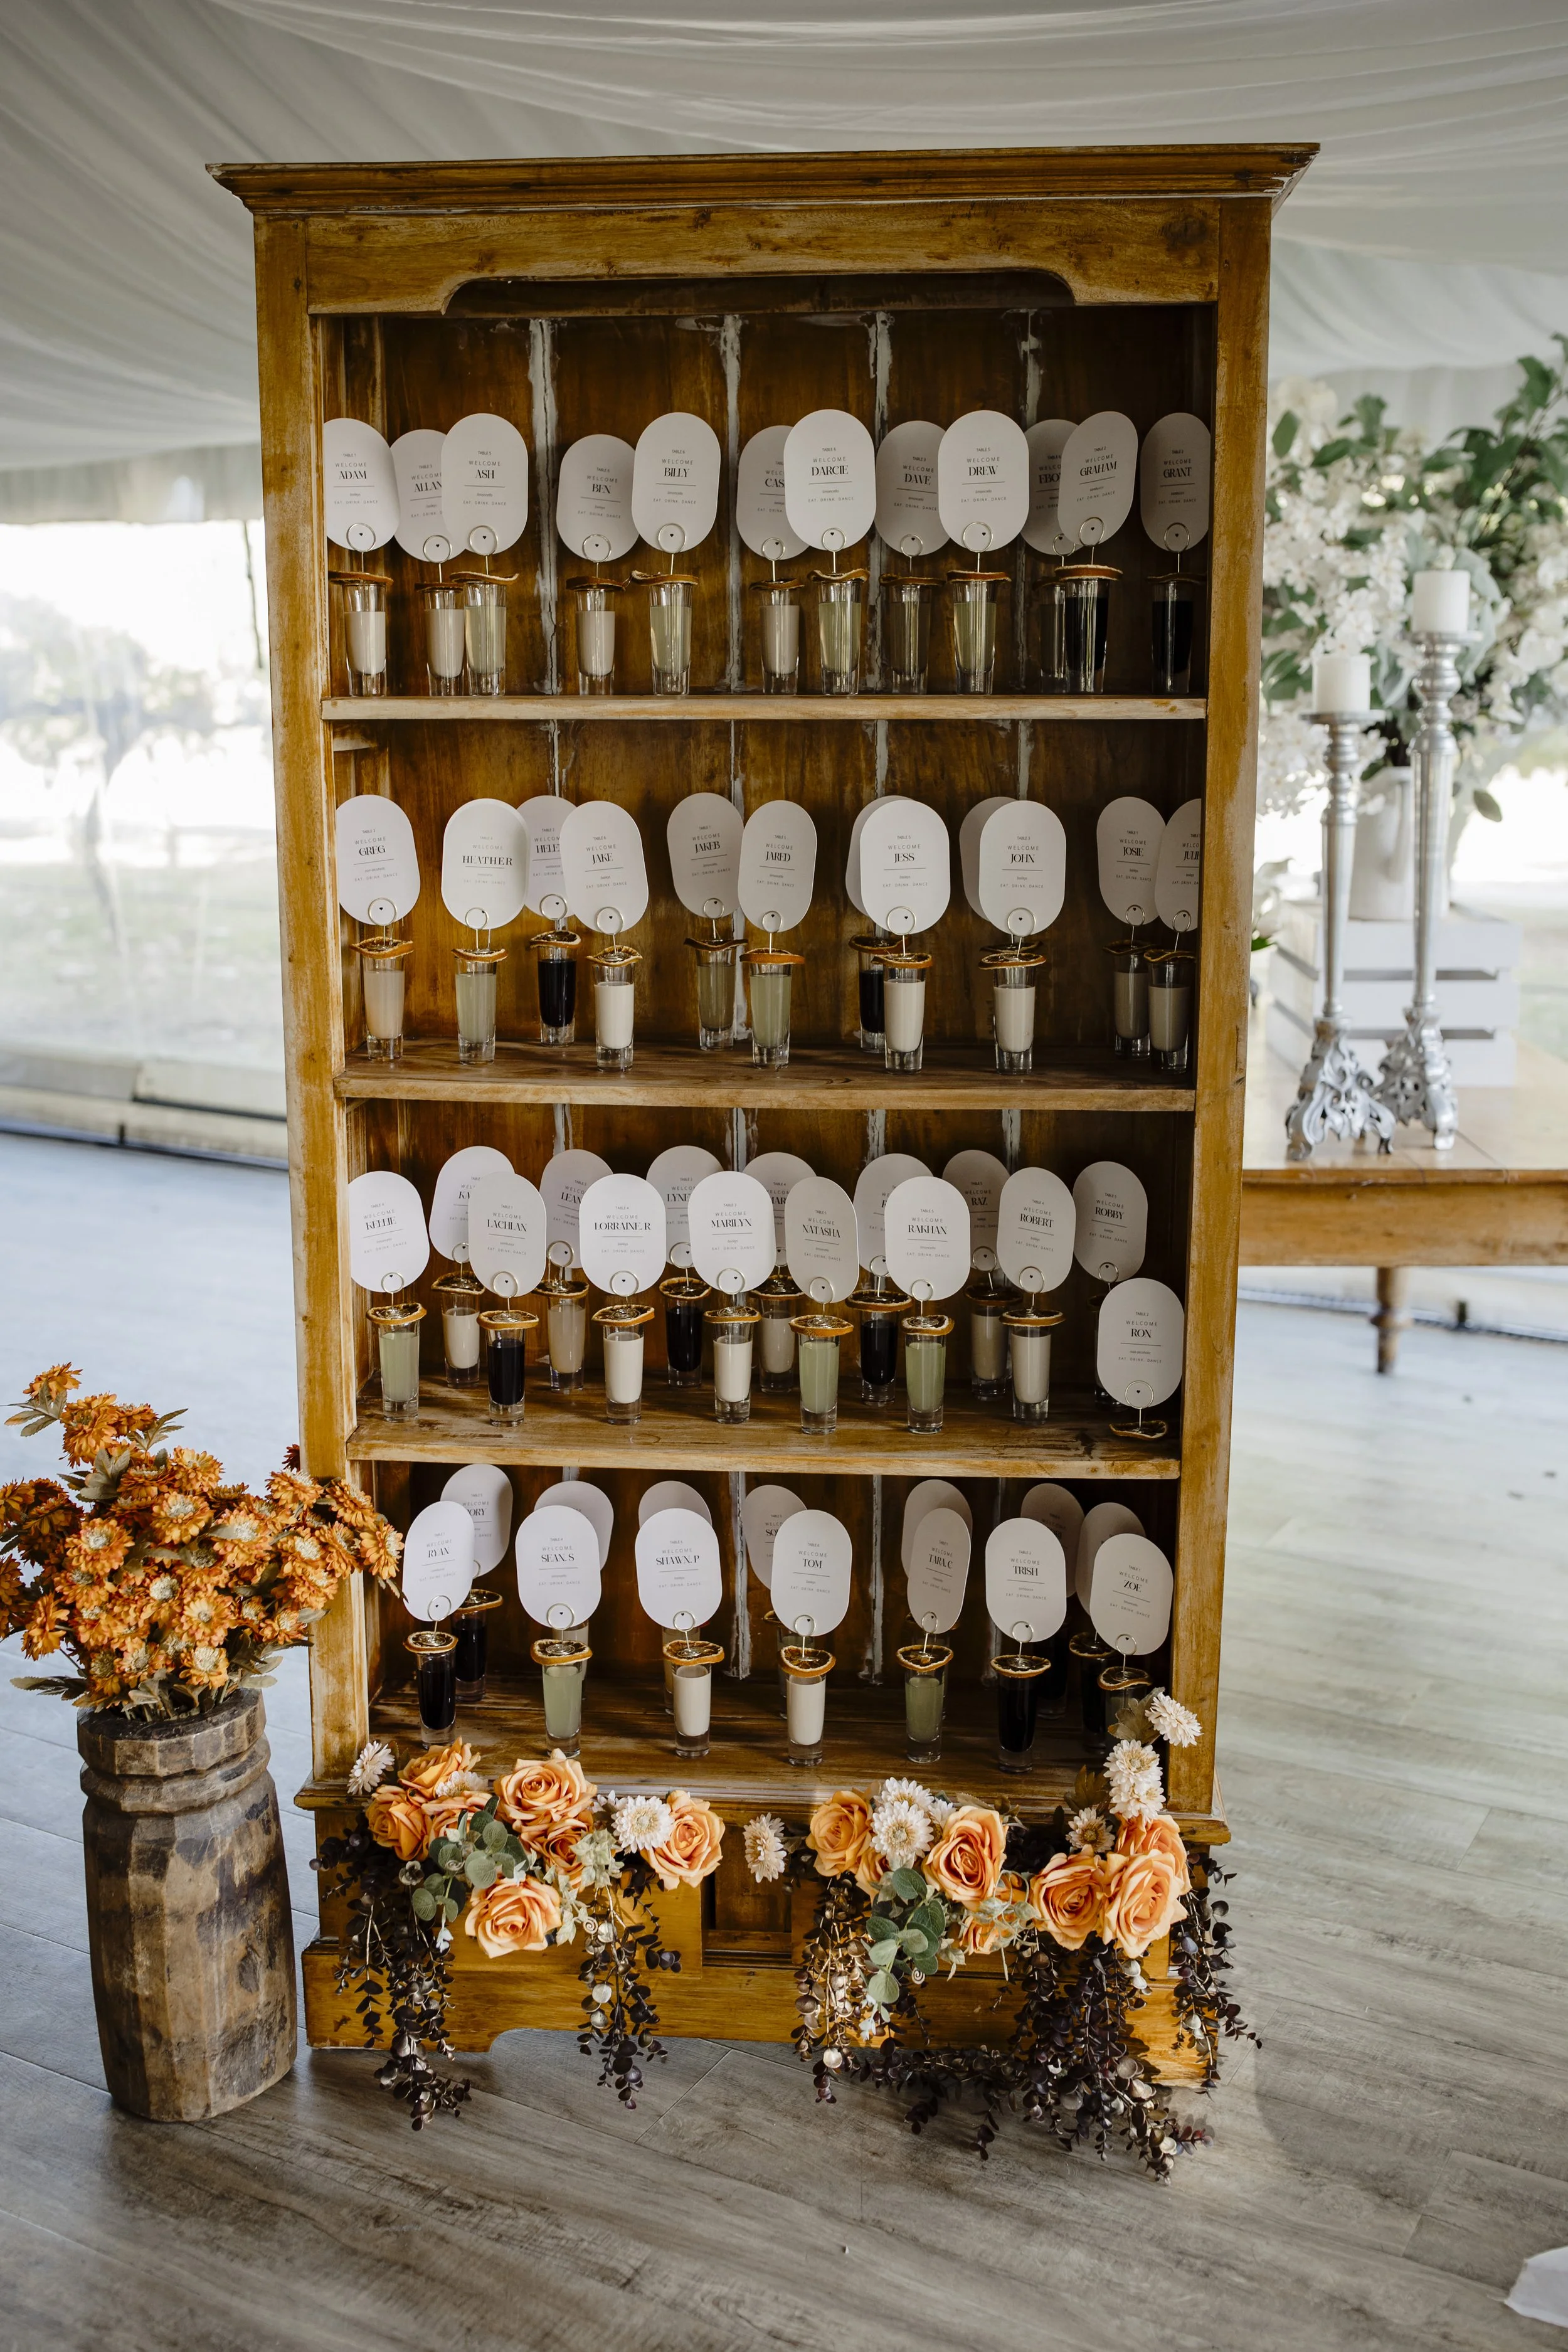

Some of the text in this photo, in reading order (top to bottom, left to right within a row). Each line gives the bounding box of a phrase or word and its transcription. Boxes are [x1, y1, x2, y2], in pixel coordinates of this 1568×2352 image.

[1085, 453, 1113, 463] WELCOME
[664, 467, 689, 477] BILLY
[812, 465, 848, 476] DARCIE
[903, 465, 934, 473] WELCOME
[969, 465, 998, 476] DREW
[1079, 461, 1117, 477] GRAHAM
[1163, 467, 1192, 478] GRANT
[339, 470, 367, 480] ADAM
[475, 470, 494, 479] ASH
[904, 474, 931, 485] DAVE
[1039, 472, 1061, 484] EBO
[592, 484, 612, 494] BEN
[354, 837, 386, 845] WELCOME
[692, 833, 720, 841] WELCOME
[359, 845, 386, 856] GREG
[695, 841, 720, 854] JAKEB
[1123, 847, 1144, 857] JOSIE
[462, 856, 512, 866] HEATHER
[592, 853, 613, 864] JAKE
[765, 851, 791, 862] JARED
[894, 853, 914, 863] JESS
[1010, 854, 1036, 864] JOHN
[971, 1197, 988, 1206] RAZ
[1096, 1199, 1123, 1209] WELCOME
[363, 1209, 396, 1219] WELCOME
[1024, 1207, 1051, 1216] WELCOME
[1095, 1207, 1125, 1220] ROBBY
[366, 1216, 397, 1230] KELLIE
[487, 1219, 527, 1232] LACHLAN
[711, 1219, 751, 1228] MARILYN
[1020, 1214, 1054, 1228] ROBERT
[802, 1224, 840, 1238] NATASHA
[908, 1224, 948, 1234] RAKHAN
[1131, 1328, 1152, 1338] RON
[426, 1539, 452, 1547] WELCOME
[428, 1547, 450, 1558] RYAN
[932, 1547, 953, 1557] WELCOME
[803, 1559, 822, 1569] TOM
[947, 1560, 953, 1569] C
[1012, 1565, 1039, 1576] TRISH
[1119, 1571, 1148, 1584] WELCOME
[1124, 1579, 1142, 1593] ZOE
